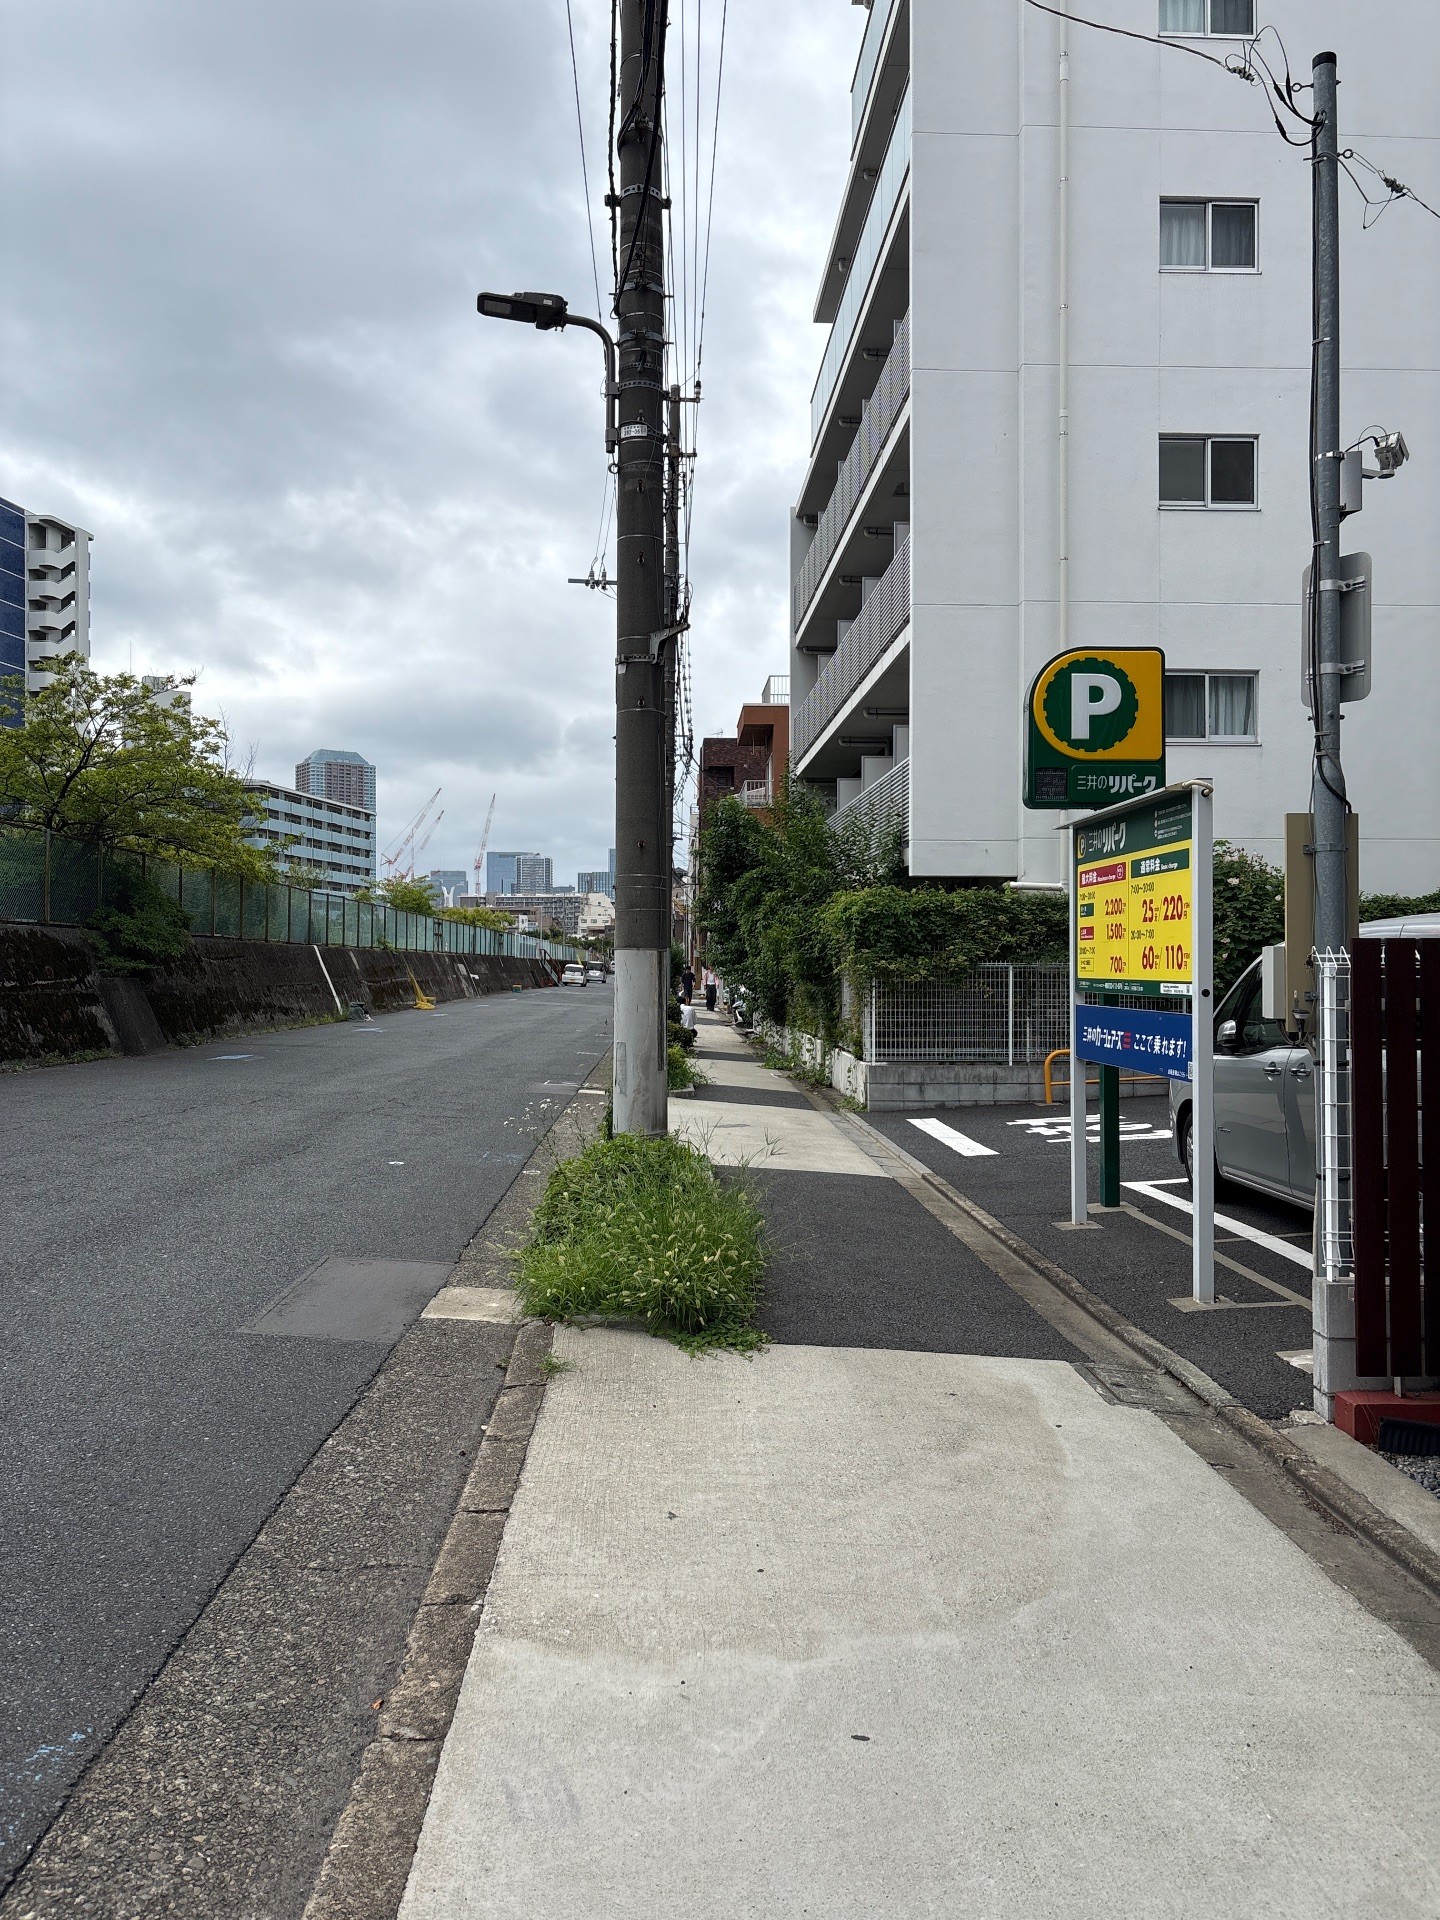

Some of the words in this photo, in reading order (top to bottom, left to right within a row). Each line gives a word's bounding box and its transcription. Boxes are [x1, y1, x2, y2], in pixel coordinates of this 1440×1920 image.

[1070, 673, 1122, 740] P
[1077, 774, 1156, 794] 三井のリパーク
[1088, 822, 1126, 854] 三井のリパーク
[1105, 898, 1122, 917] 2,200
[1142, 898, 1154, 923] 25
[1163, 894, 1183, 921] 220
[1106, 922, 1122, 941] 1,500
[1110, 956, 1122, 973] 700
[1142, 945, 1154, 970] 60
[1165, 944, 1184, 970] 110
[1082, 1025, 1124, 1050] 三井のカーシェアーズ
